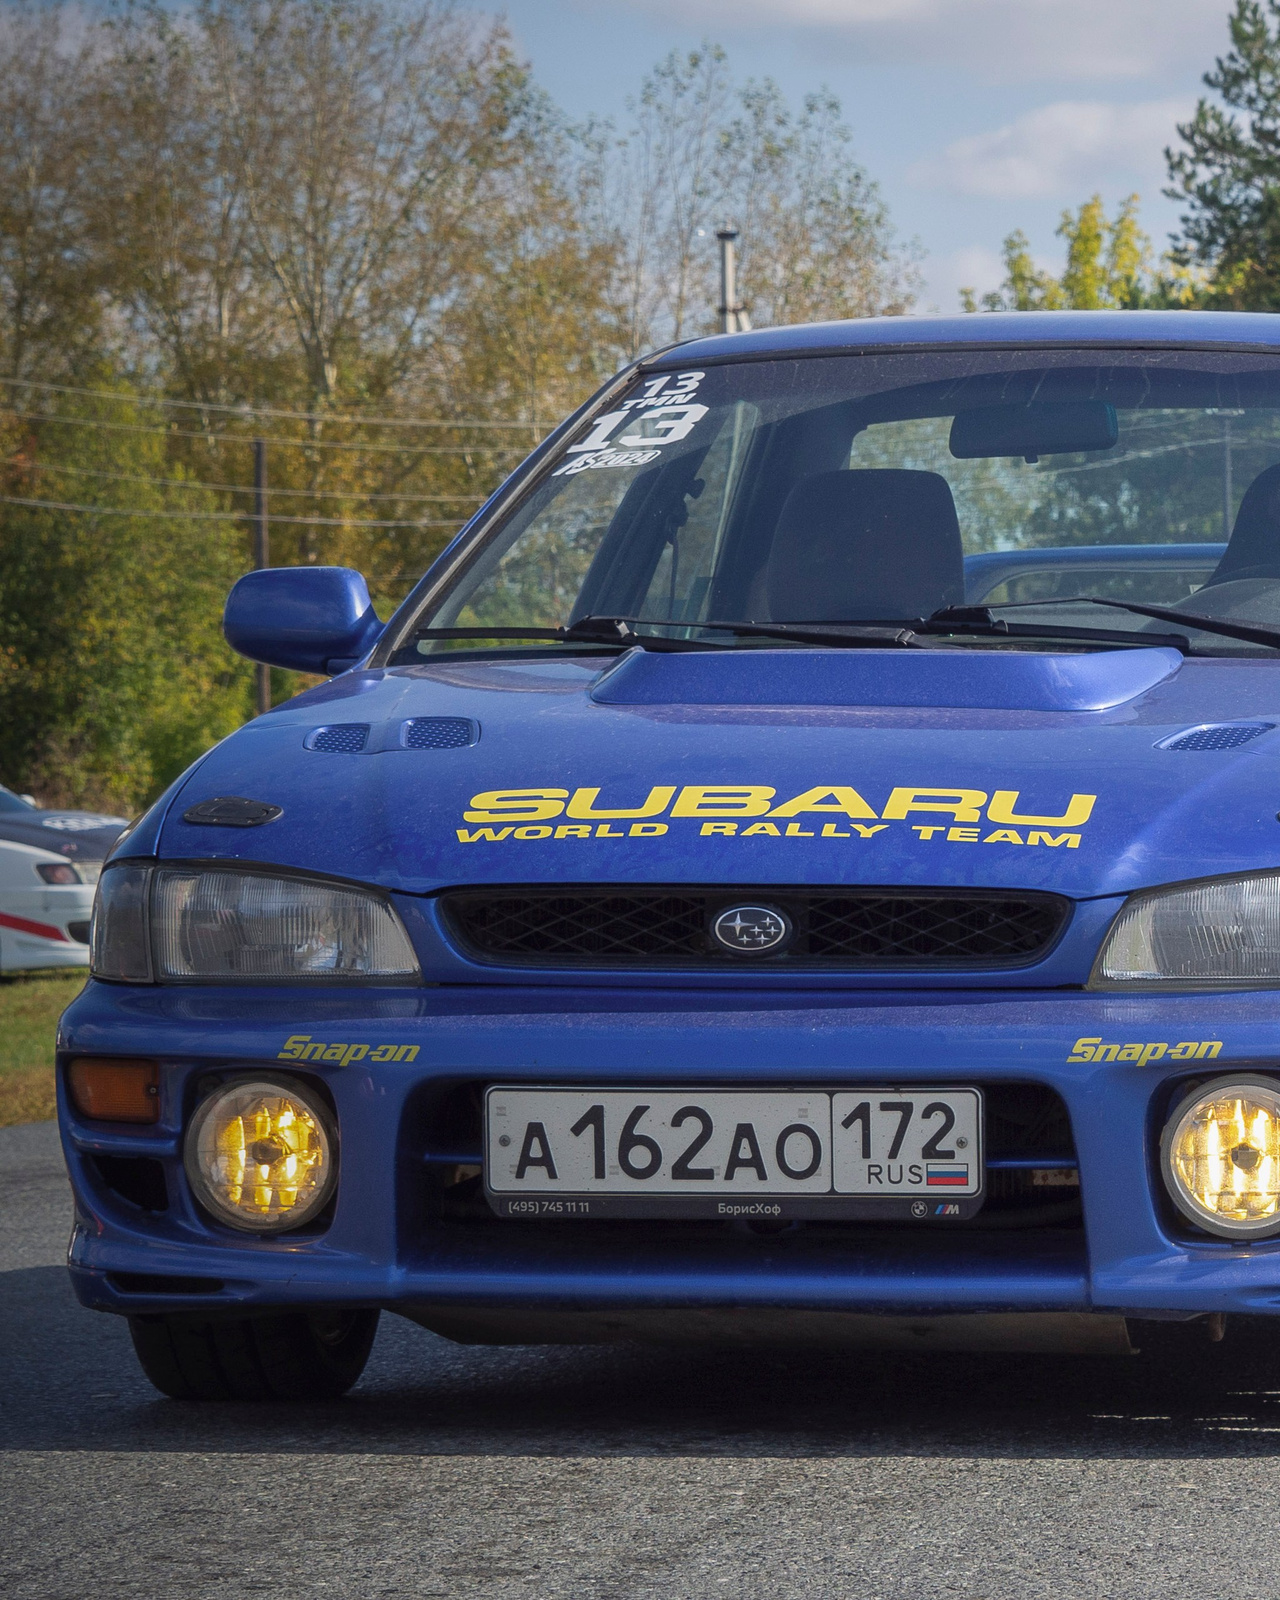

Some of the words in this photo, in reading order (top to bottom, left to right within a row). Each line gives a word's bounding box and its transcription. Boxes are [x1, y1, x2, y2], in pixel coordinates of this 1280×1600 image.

[643, 371, 706, 398] 13
[622, 392, 697, 410] TMN
[566, 403, 710, 453] 13
[463, 785, 1098, 827] SUBARU
[455, 822, 669, 843] WORLD
[699, 822, 890, 838] RALLY
[910, 825, 1083, 848] TEAM
[276, 1035, 421, 1067] Snap-on
[1066, 1037, 1224, 1067] Snap-on
[840, 1101, 957, 1160] 172
[867, 1163, 923, 1185] RUS
[508, 1200, 540, 1215] (495)
[542, 1201, 564, 1213] 745
[565, 1201, 577, 1213] 11
[579, 1201, 590, 1213] 11
[717, 1202, 782, 1216] БорисХоф
